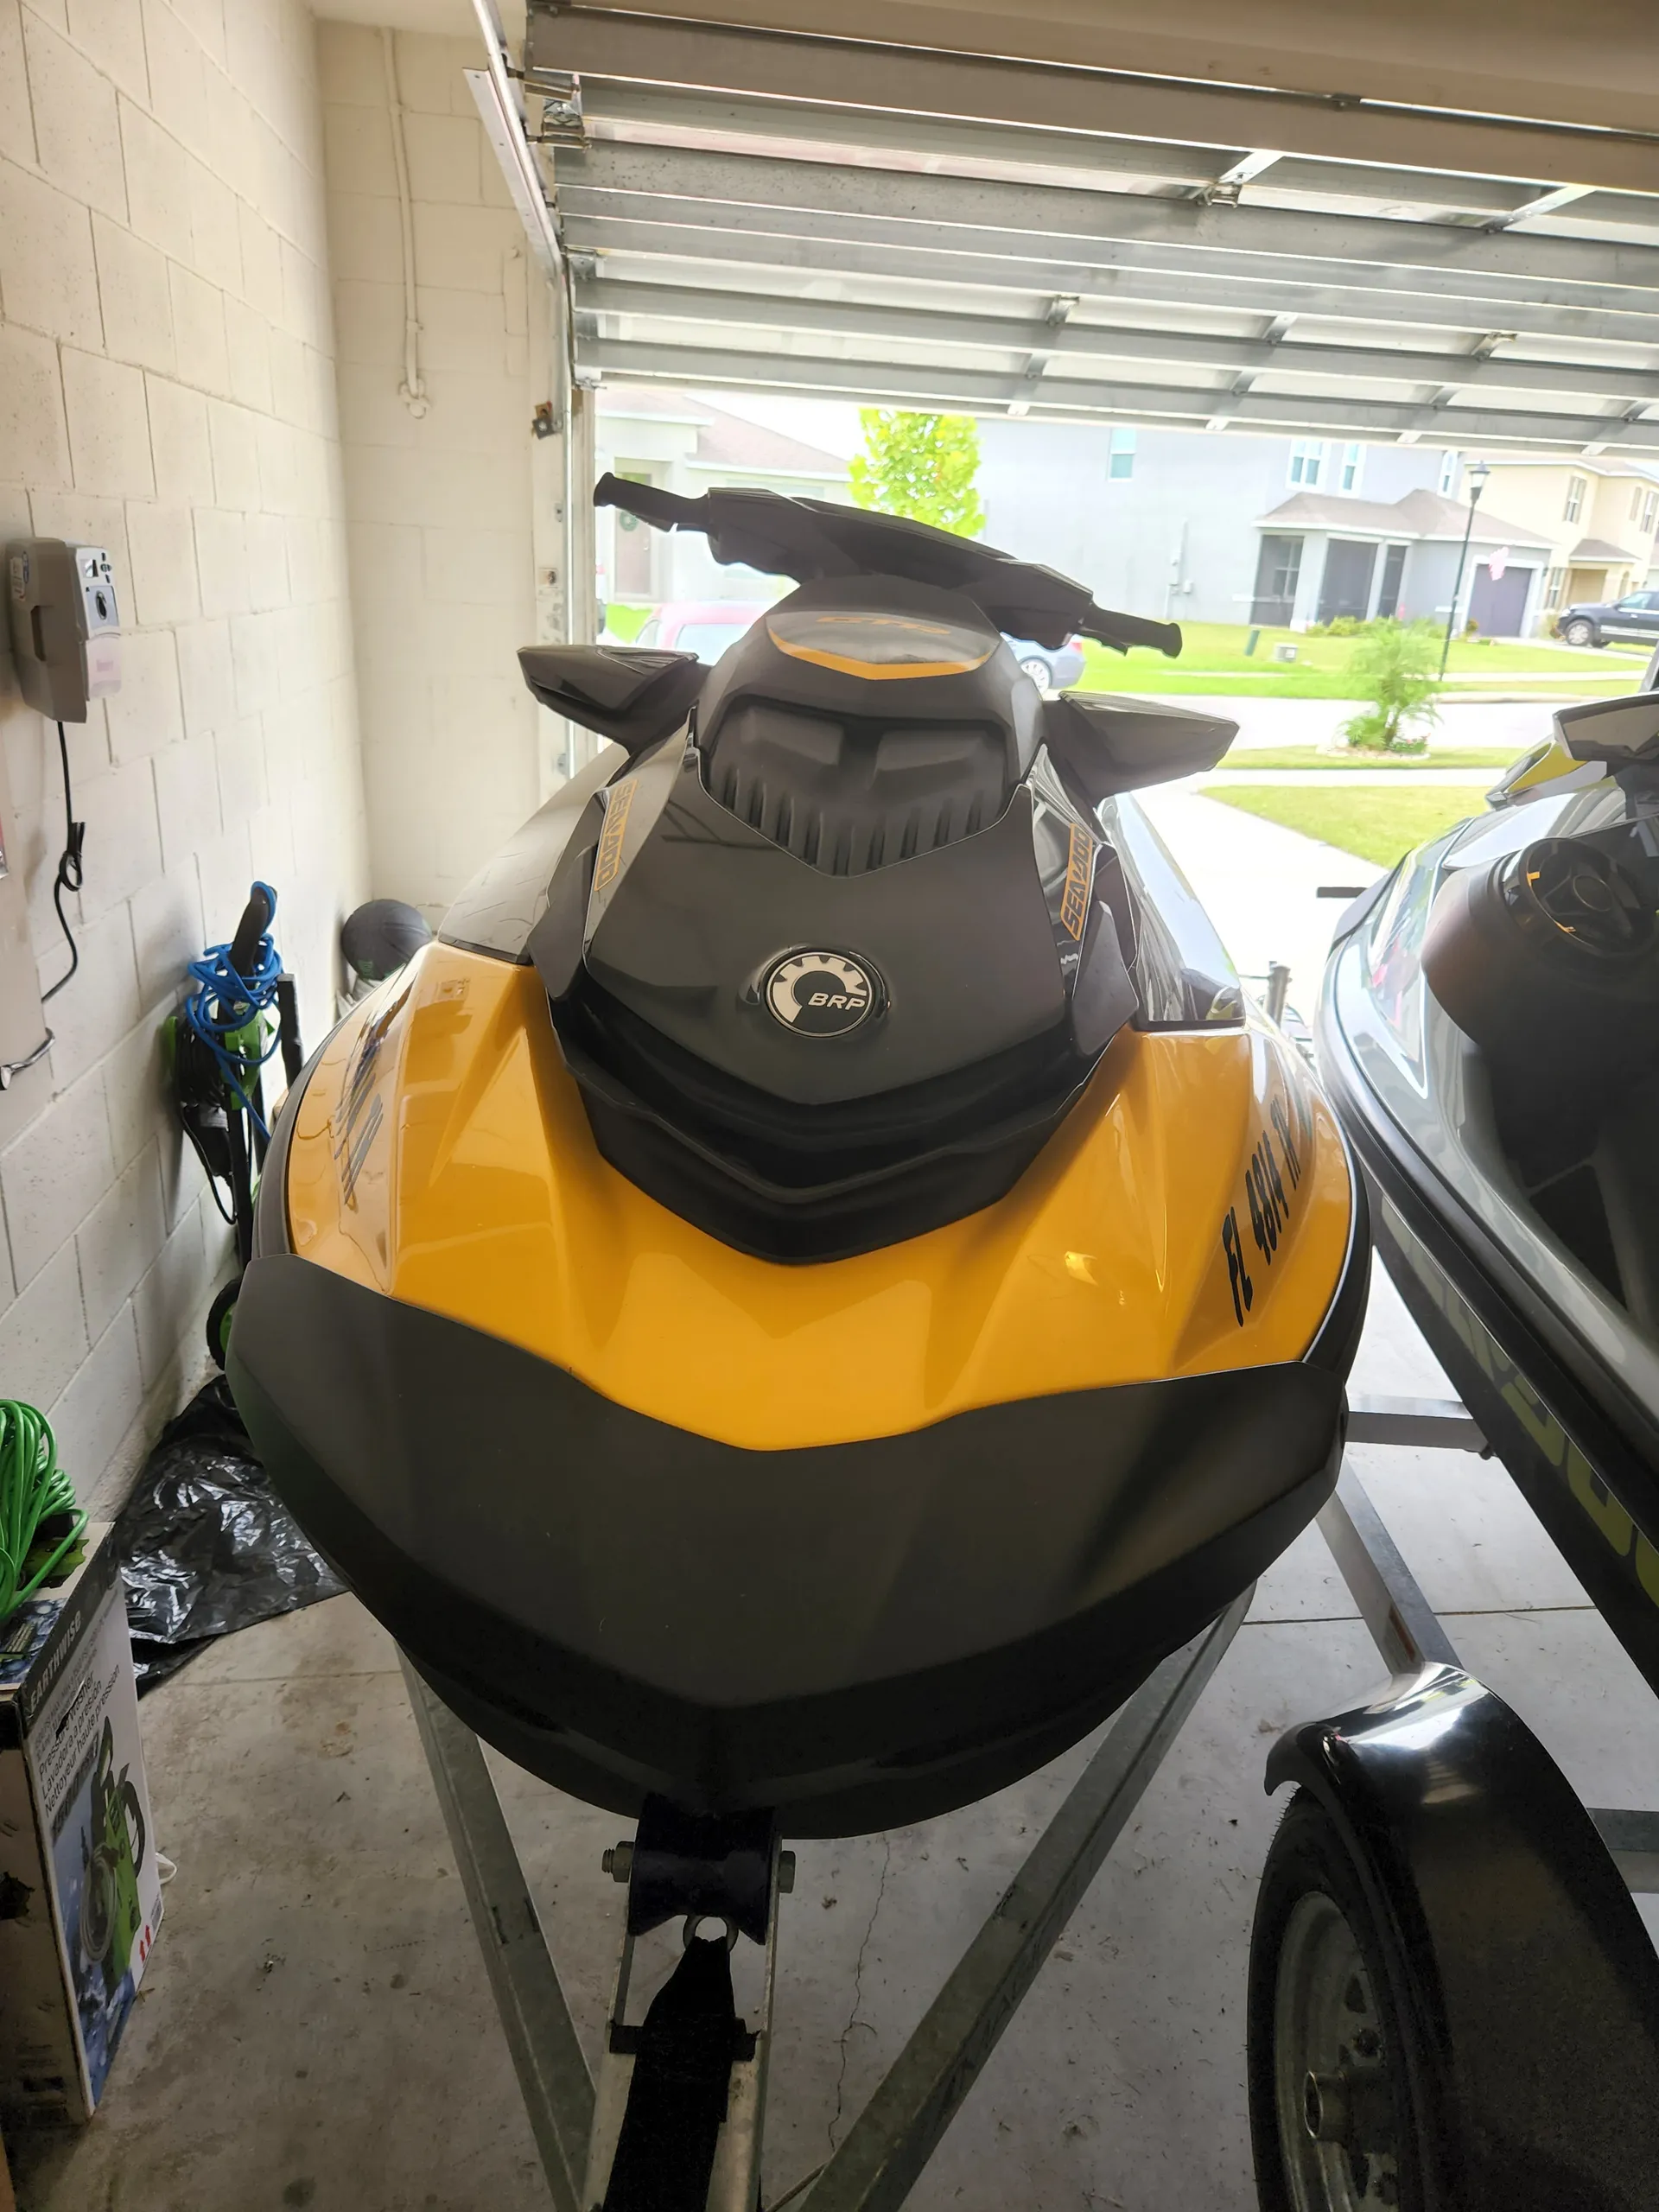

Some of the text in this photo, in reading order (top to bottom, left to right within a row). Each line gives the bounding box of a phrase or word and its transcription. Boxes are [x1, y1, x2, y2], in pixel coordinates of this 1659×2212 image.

[808, 992, 865, 1011] BRP
[1222, 1206, 1254, 1327] FL
[1245, 1129, 1289, 1266] 4814
[41, 1734, 74, 1801] Lavadora
[45, 1747, 78, 1819] Nettoyeur
[77, 1714, 96, 1754] haute
[95, 1663, 121, 1722] pression
